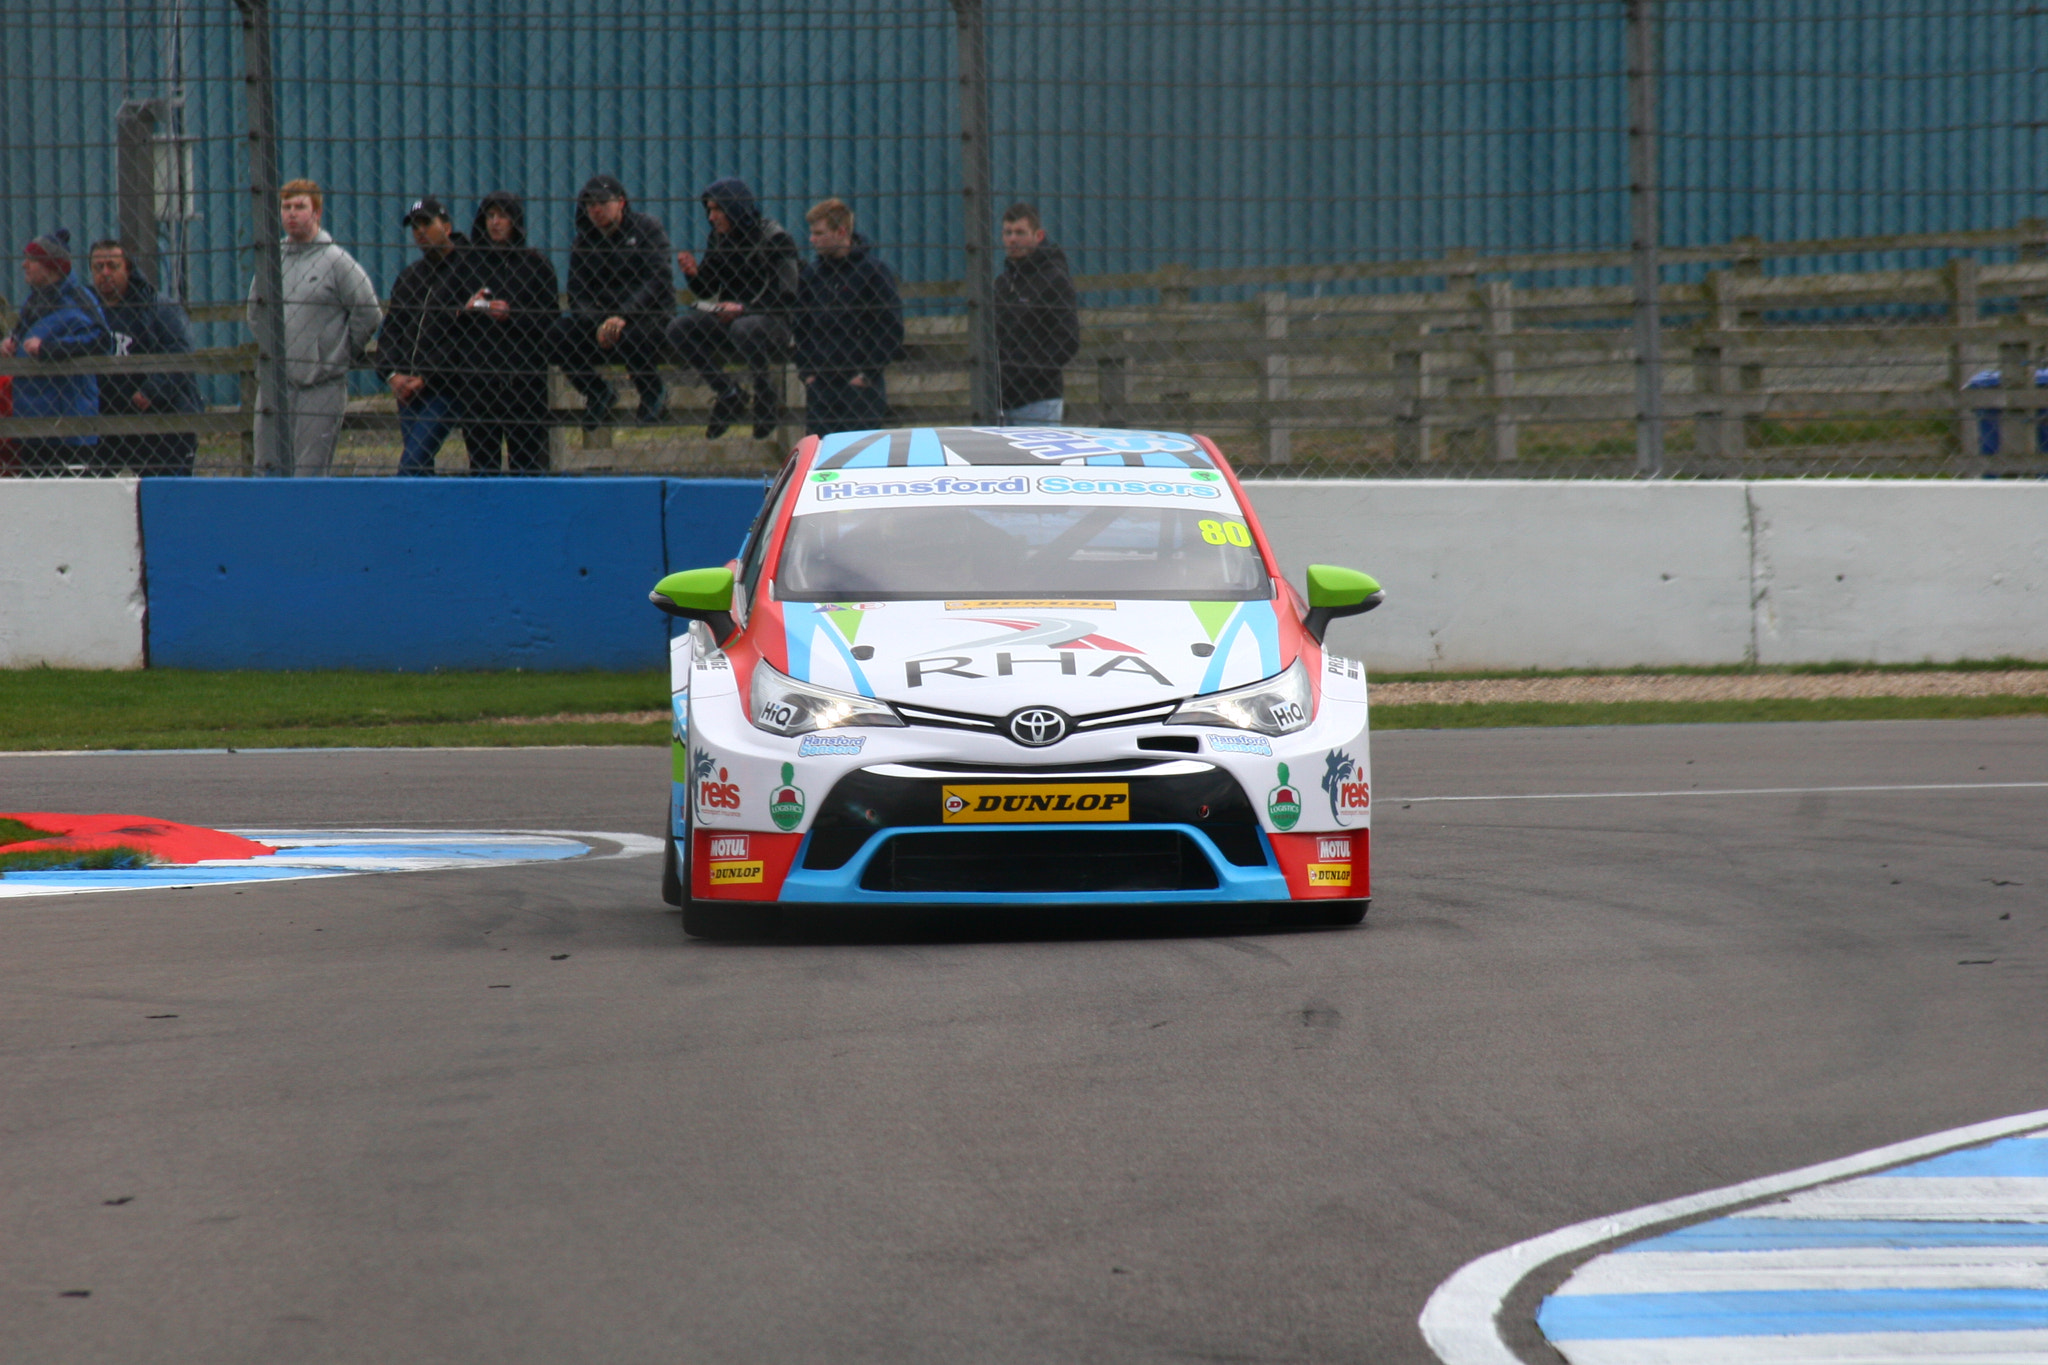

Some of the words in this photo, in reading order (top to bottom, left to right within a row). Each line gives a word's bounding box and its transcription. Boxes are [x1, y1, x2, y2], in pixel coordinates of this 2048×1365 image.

[820, 476, 1026, 500] Hansford
[1041, 477, 1217, 497] Sensors
[1198, 519, 1252, 548] 80
[905, 652, 1175, 688] RHA
[761, 701, 791, 726] HiQ
[1273, 702, 1304, 727] HiQ
[800, 744, 861, 756] Sensors
[803, 735, 864, 746] Hansford
[1208, 735, 1268, 746] Hansford
[701, 767, 741, 809] reis
[1340, 766, 1369, 808] reis
[771, 804, 803, 813] LOGISTICS
[973, 793, 1127, 812] DUNLOP
[1270, 804, 1300, 814] LOGISTICS
[710, 838, 746, 857] MOTUL
[1320, 840, 1351, 859] MOTUL
[715, 866, 760, 879] DUNLOP
[1318, 869, 1351, 881] DUNLOP
